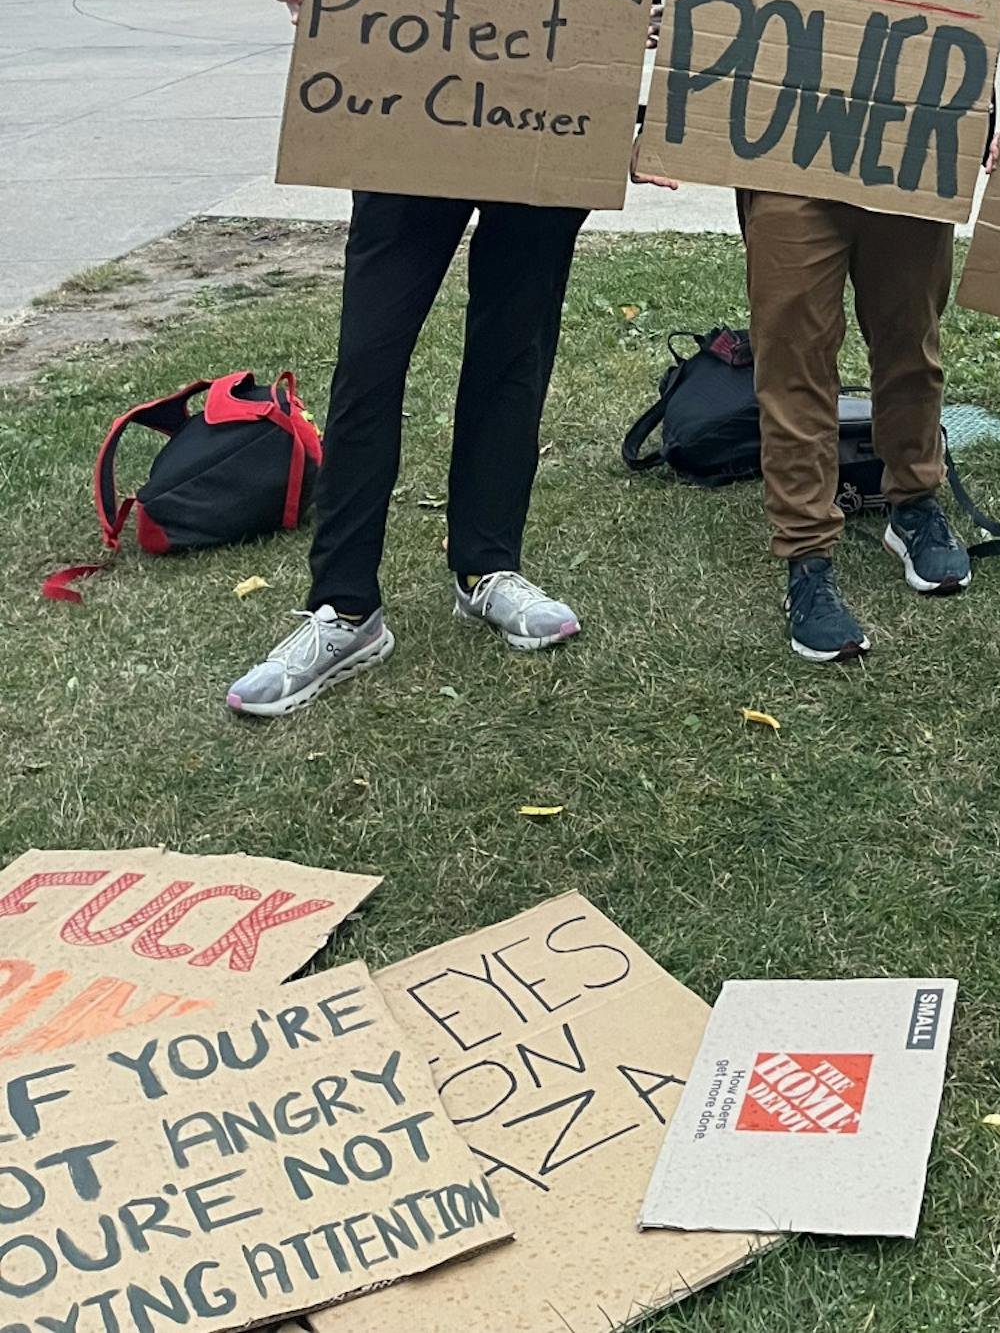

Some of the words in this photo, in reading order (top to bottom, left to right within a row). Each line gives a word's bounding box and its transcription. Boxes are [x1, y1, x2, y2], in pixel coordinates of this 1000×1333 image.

[299, 71, 402, 115] Our
[424, 75, 591, 136] Classes
[0, 870, 335, 972] FUCK
[407, 915, 631, 1051] EYES
[911, 992, 938, 1045] SMALL
[0, 1064, 76, 1142] F
[107, 985, 375, 1099] YOU'RE
[438, 1023, 586, 1124] ON
[706, 1079, 723, 1108] more
[715, 1058, 730, 1076] get
[729, 1069, 746, 1096] How
[754, 1052, 861, 1133] HOME
[810, 1059, 857, 1094] THE
[0, 1139, 119, 1224] OT
[163, 1050, 407, 1168] ANGRY
[715, 1097, 737, 1131] doers
[747, 1081, 812, 1133] DEPOT
[0, 1168, 264, 1298] OUR'E
[284, 1111, 435, 1200] NOT
[0, 1260, 237, 1333] YING
[242, 1177, 500, 1299] ATTENTION
